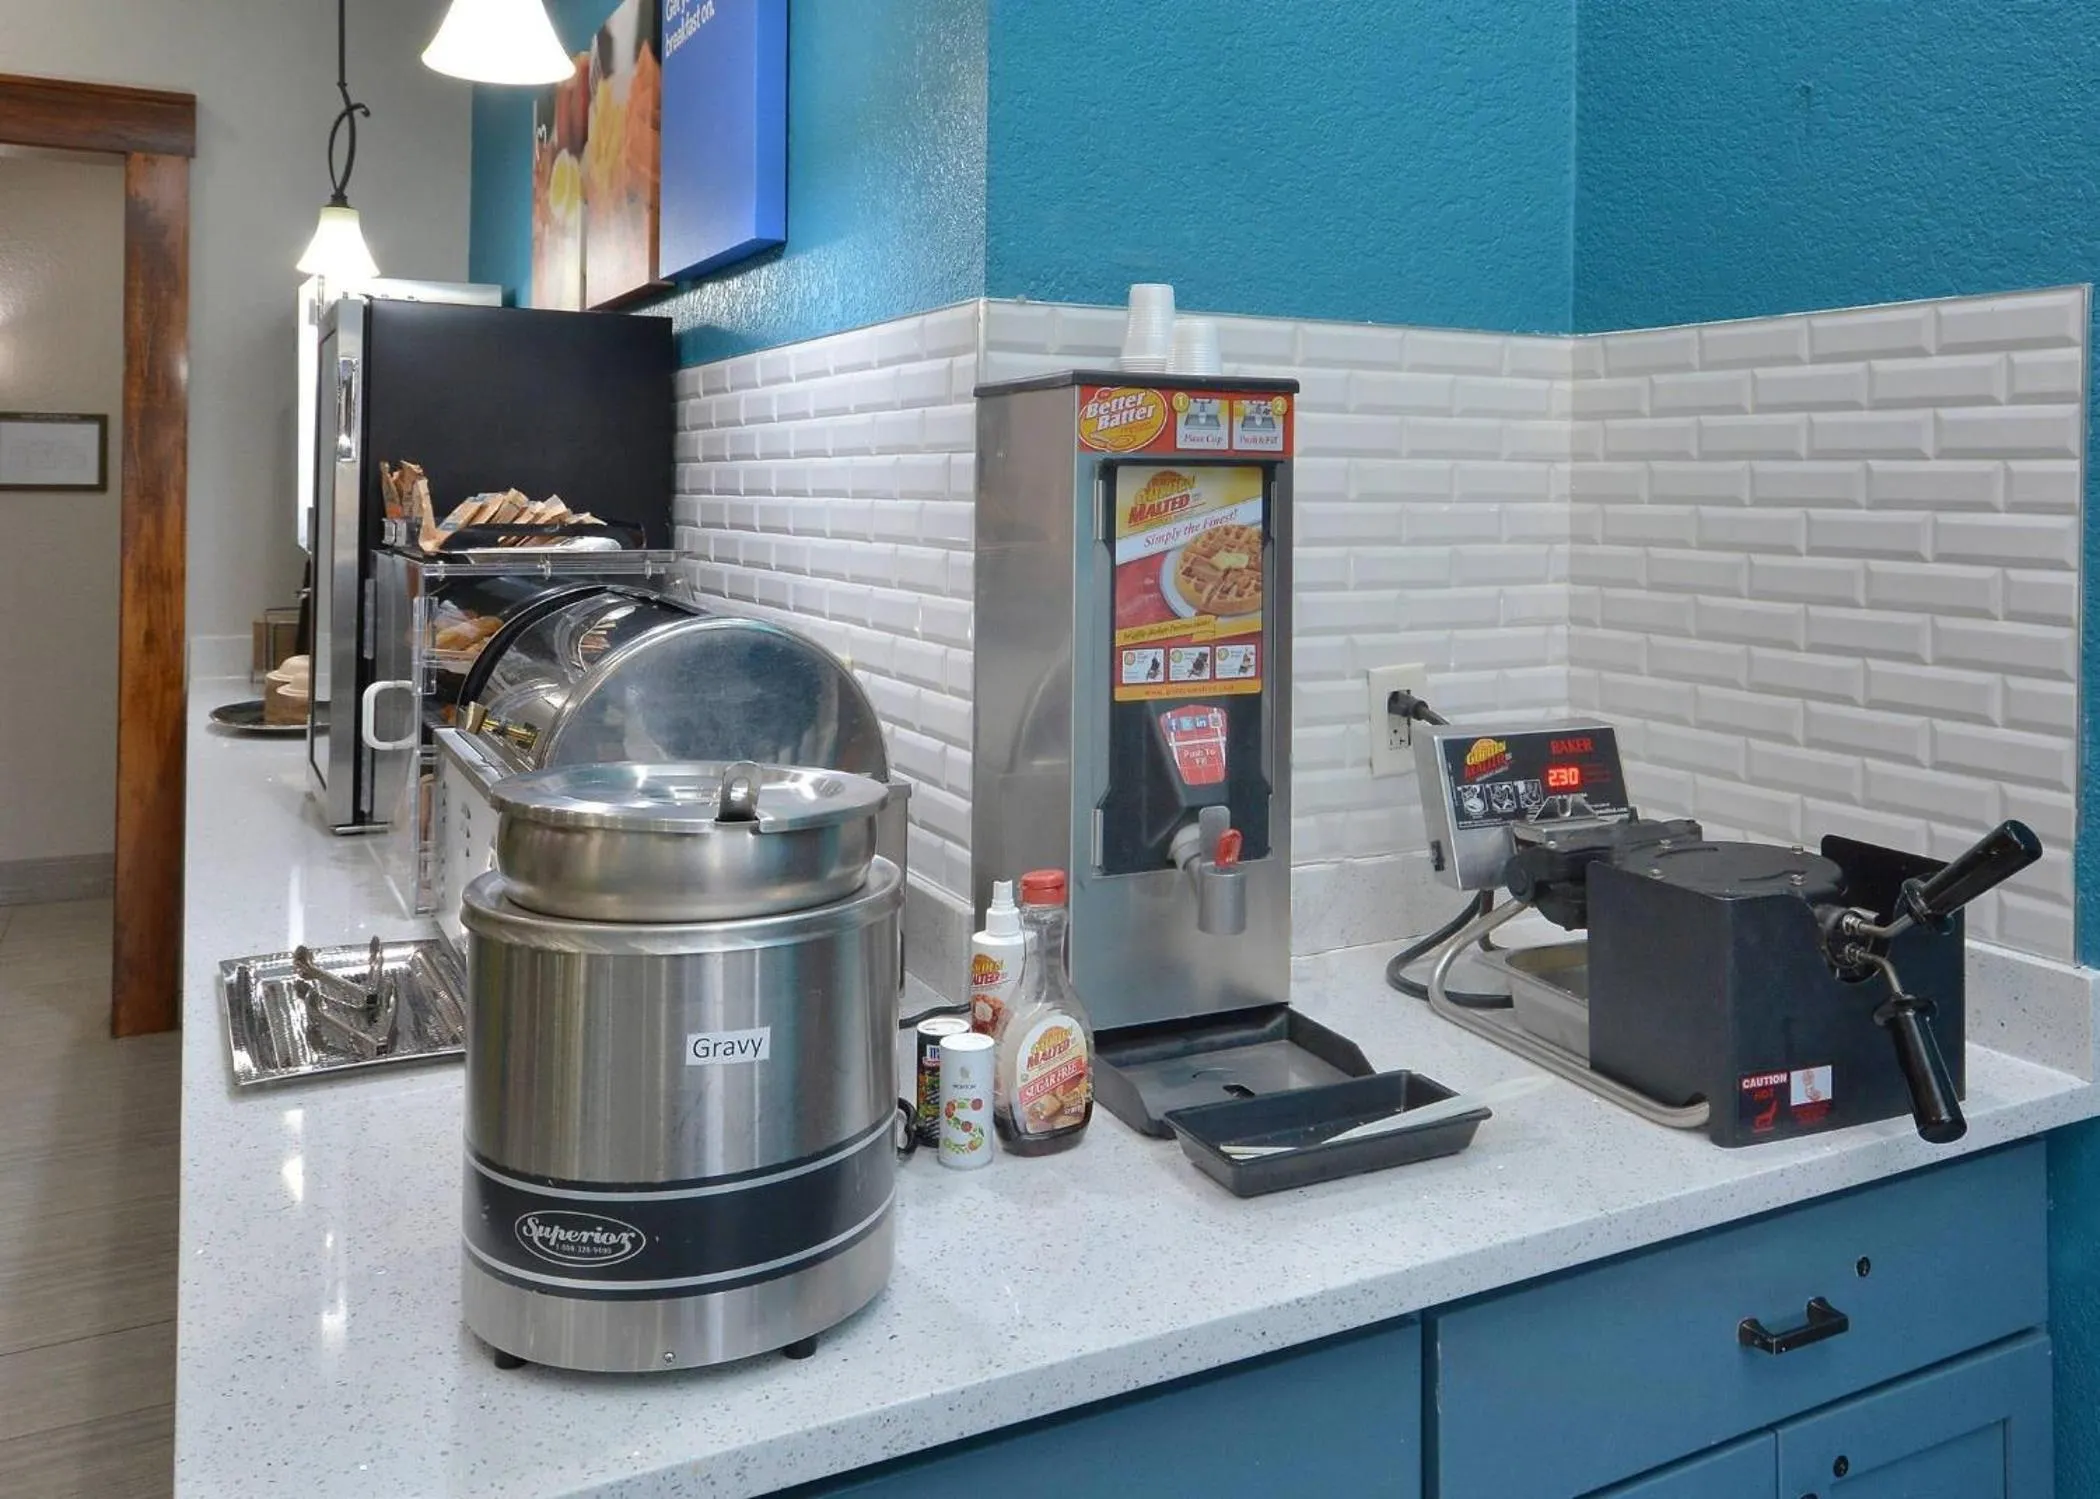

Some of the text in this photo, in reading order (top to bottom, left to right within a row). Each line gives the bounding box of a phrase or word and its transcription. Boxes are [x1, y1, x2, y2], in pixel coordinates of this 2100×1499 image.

[1086, 391, 1146, 419] Better
[1097, 404, 1156, 431] Batter
[1206, 433, 1223, 446] Cup
[1128, 493, 1191, 525] MALTED
[1143, 526, 1181, 549] Simply
[1183, 522, 1201, 537] the
[1550, 738, 1594, 755] BAKER
[1548, 767, 1579, 787] 230
[692, 1037, 764, 1059] Gravy
[1027, 1038, 1071, 1070] MALTED
[1025, 1074, 1057, 1098] SUGAR
[1057, 1063, 1078, 1082] FREE
[1742, 1072, 1788, 1089] CAUTION
[522, 1217, 636, 1252] Superior
